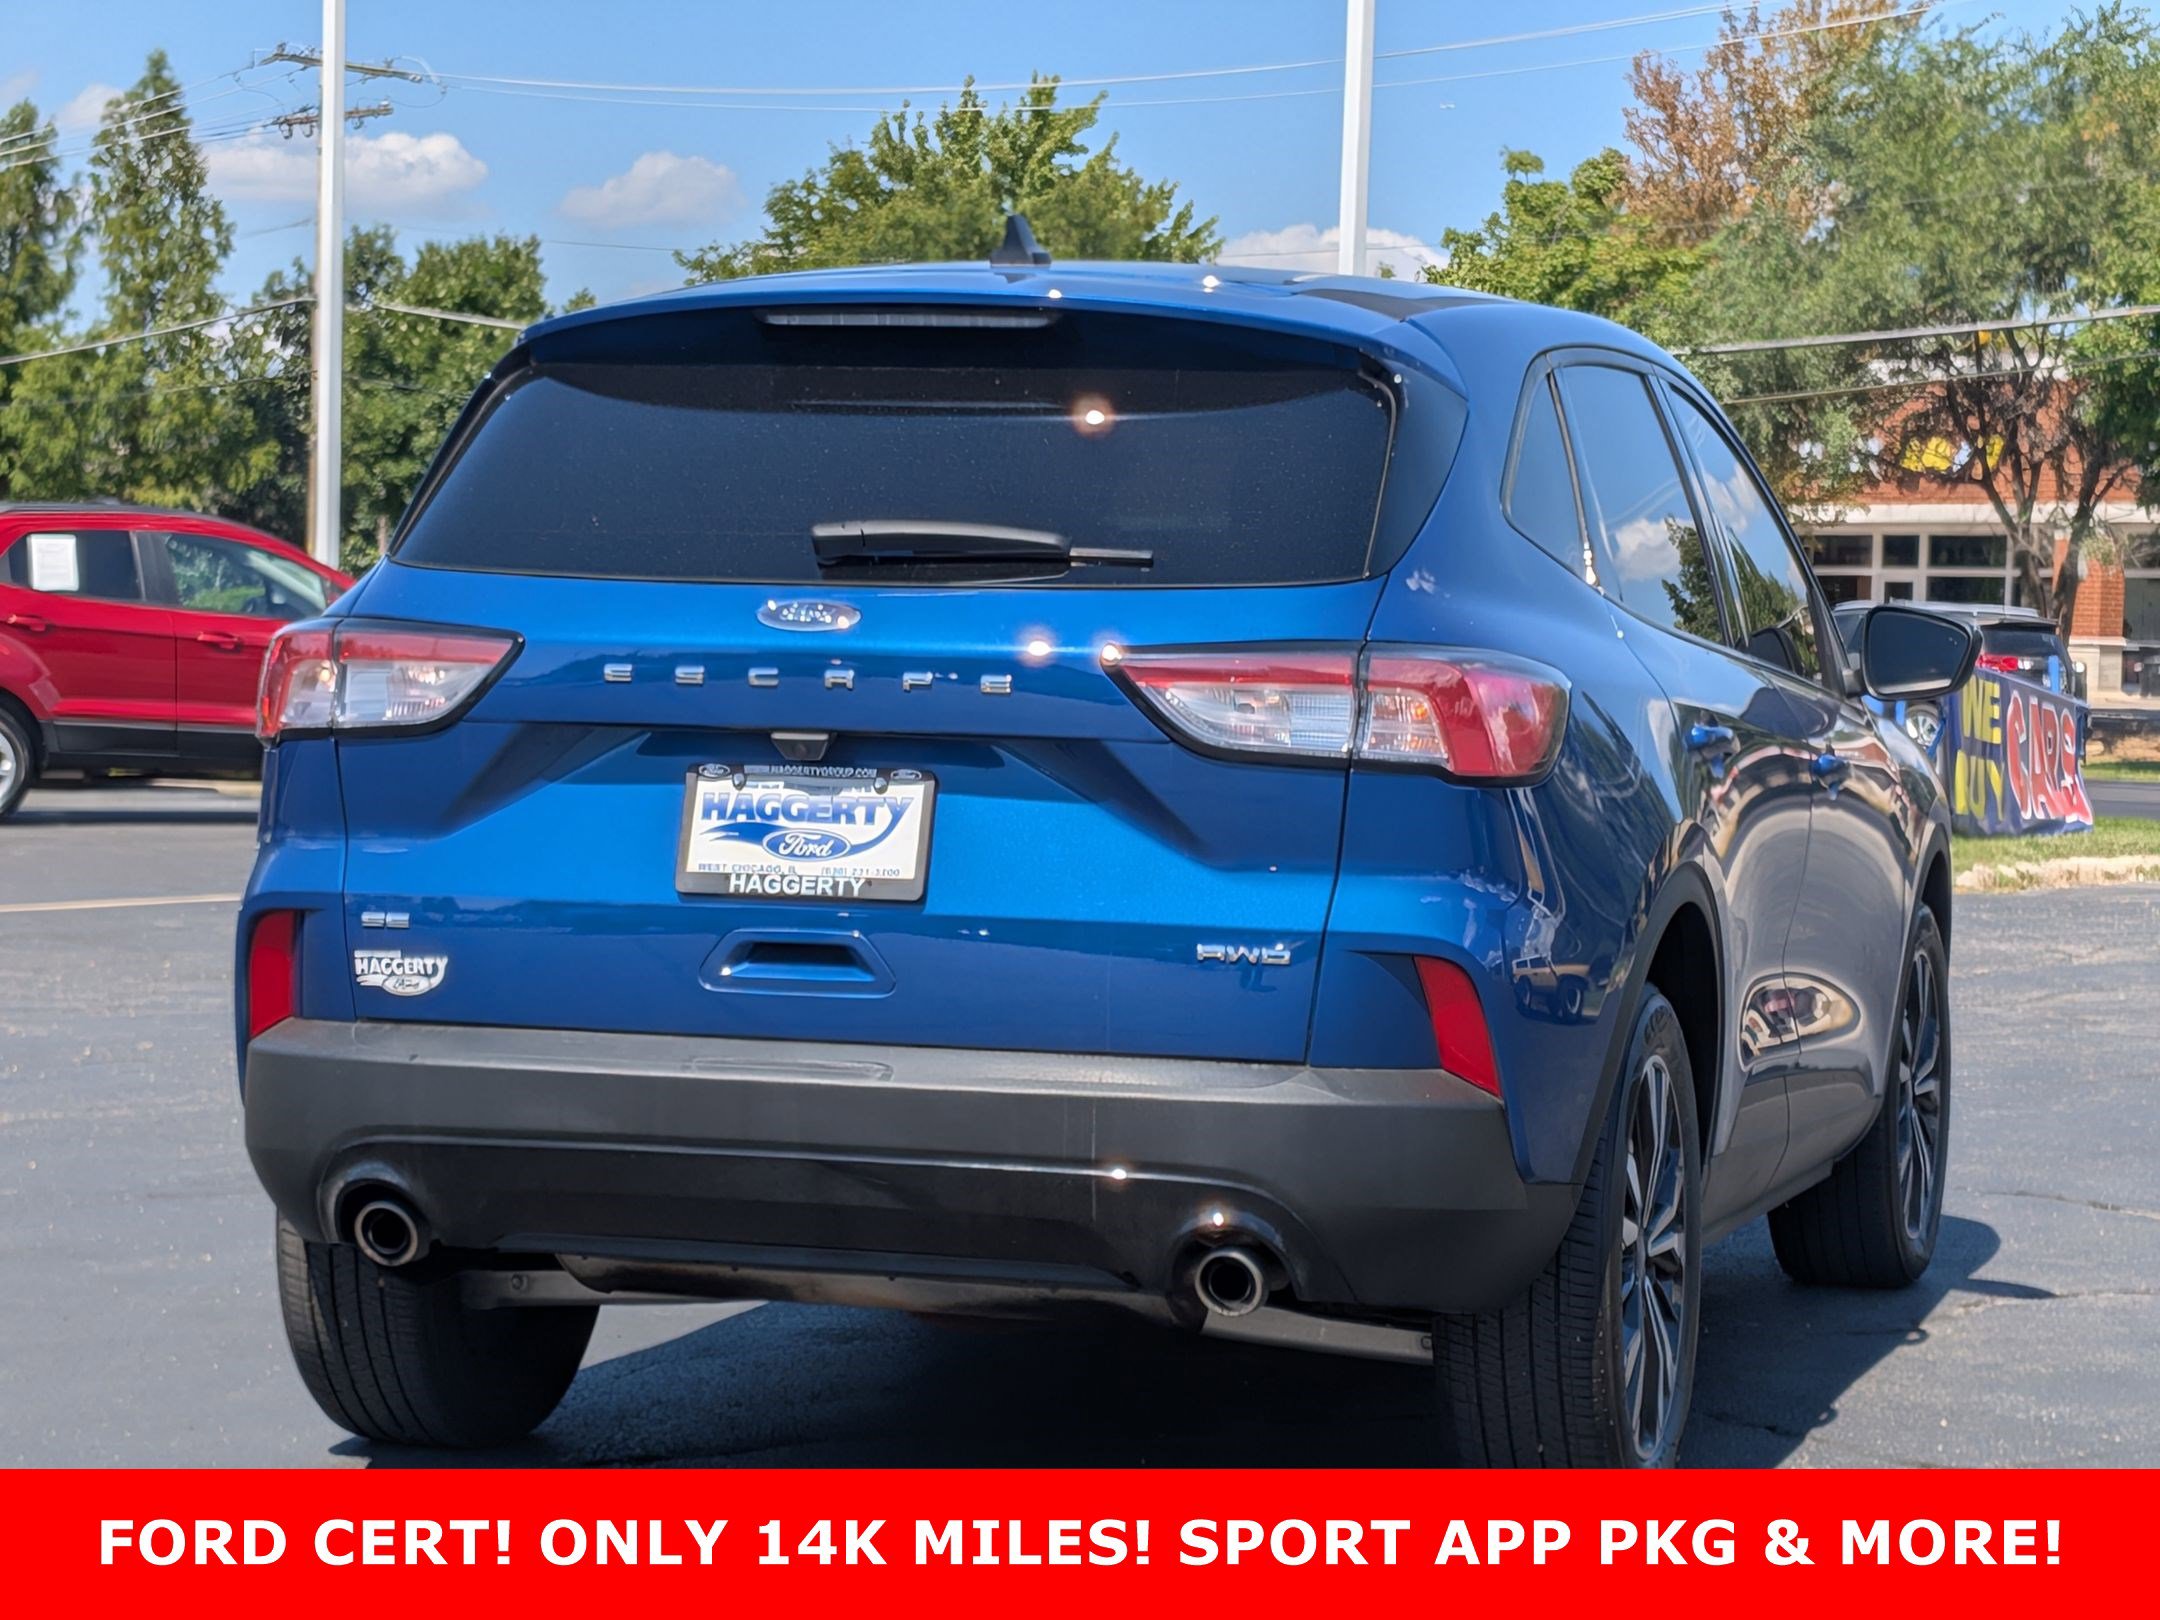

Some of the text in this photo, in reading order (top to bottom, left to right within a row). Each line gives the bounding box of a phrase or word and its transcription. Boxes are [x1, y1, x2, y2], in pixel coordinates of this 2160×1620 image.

[603, 662, 1013, 693] ESCAPE
[1962, 675, 2002, 744] WE
[2007, 689, 2093, 825] CARS
[702, 790, 914, 826] HAGGERTY
[778, 832, 832, 857] Ford
[729, 873, 866, 897] HAGGERTY
[354, 956, 449, 975] HAGGERTY
